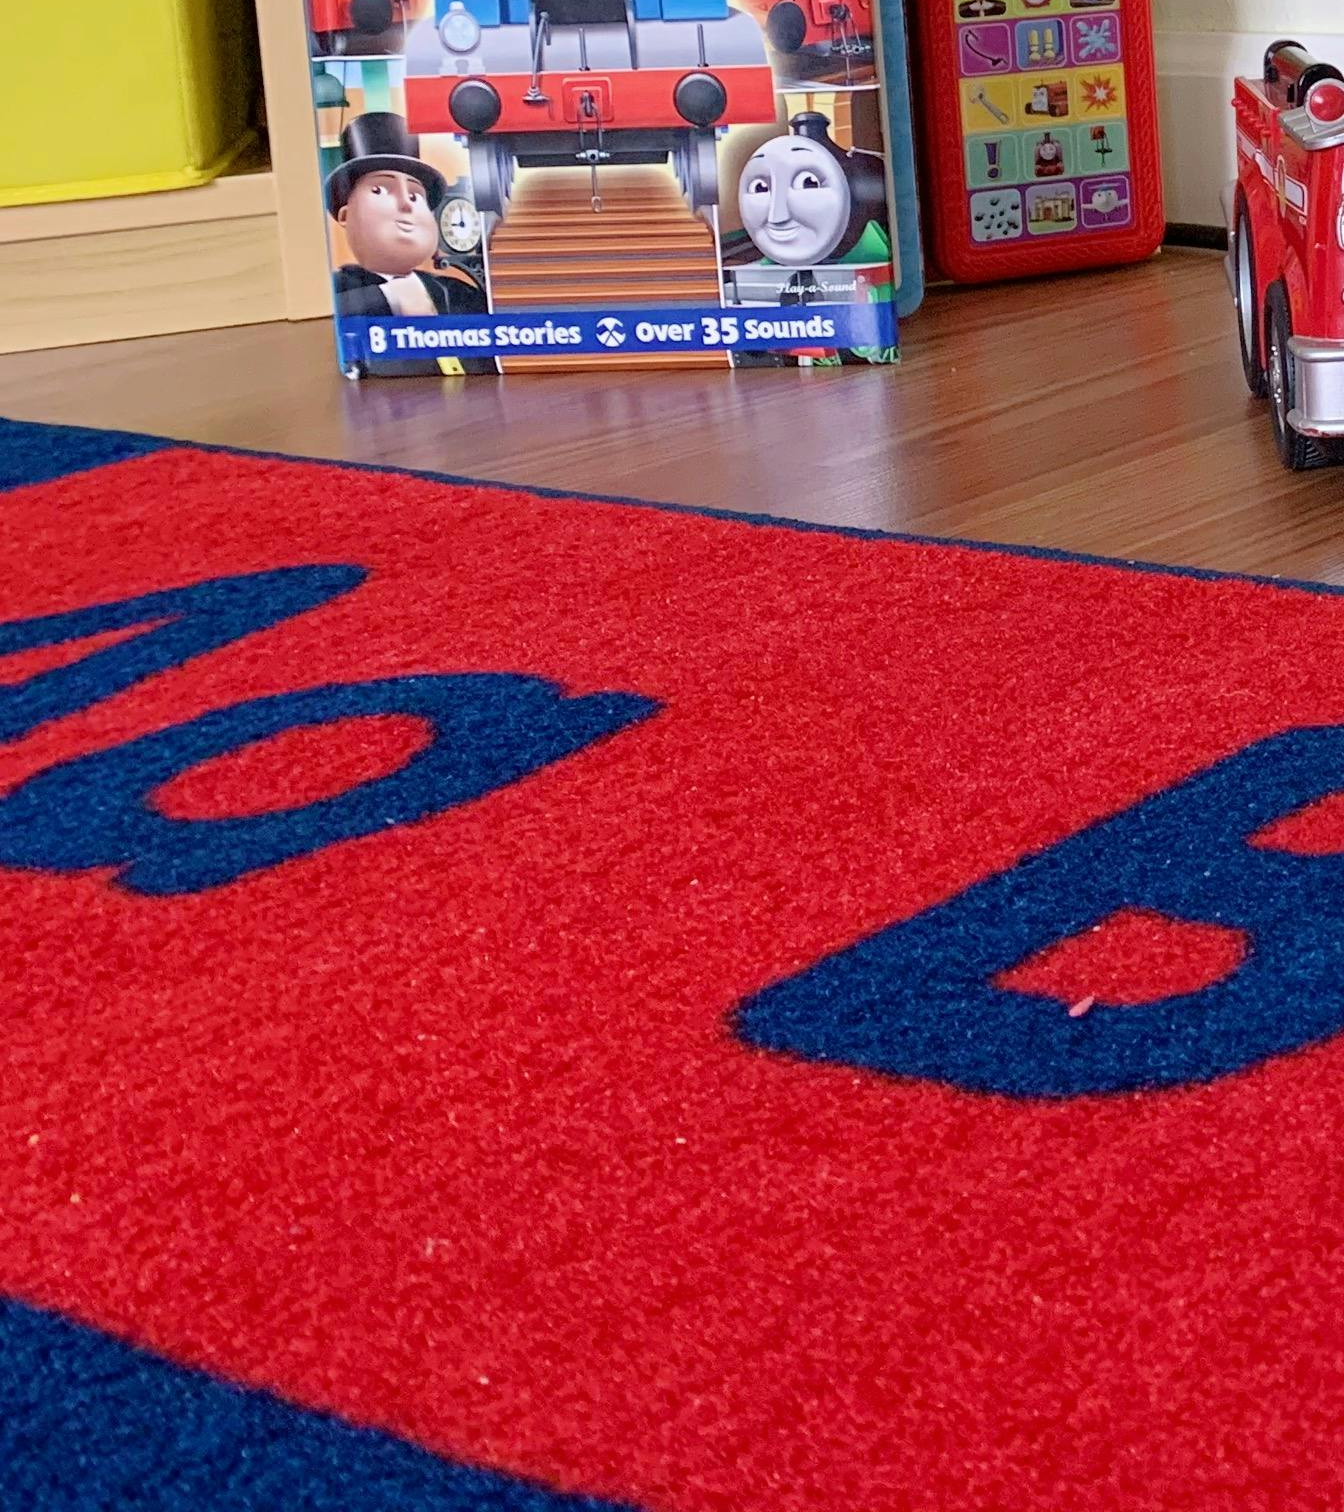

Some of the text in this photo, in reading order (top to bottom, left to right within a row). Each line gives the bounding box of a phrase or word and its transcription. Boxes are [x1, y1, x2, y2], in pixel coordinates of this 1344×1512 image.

[368, 320, 582, 353] 8 Thomas Stories
[636, 316, 836, 345] Over 35 Sounds
